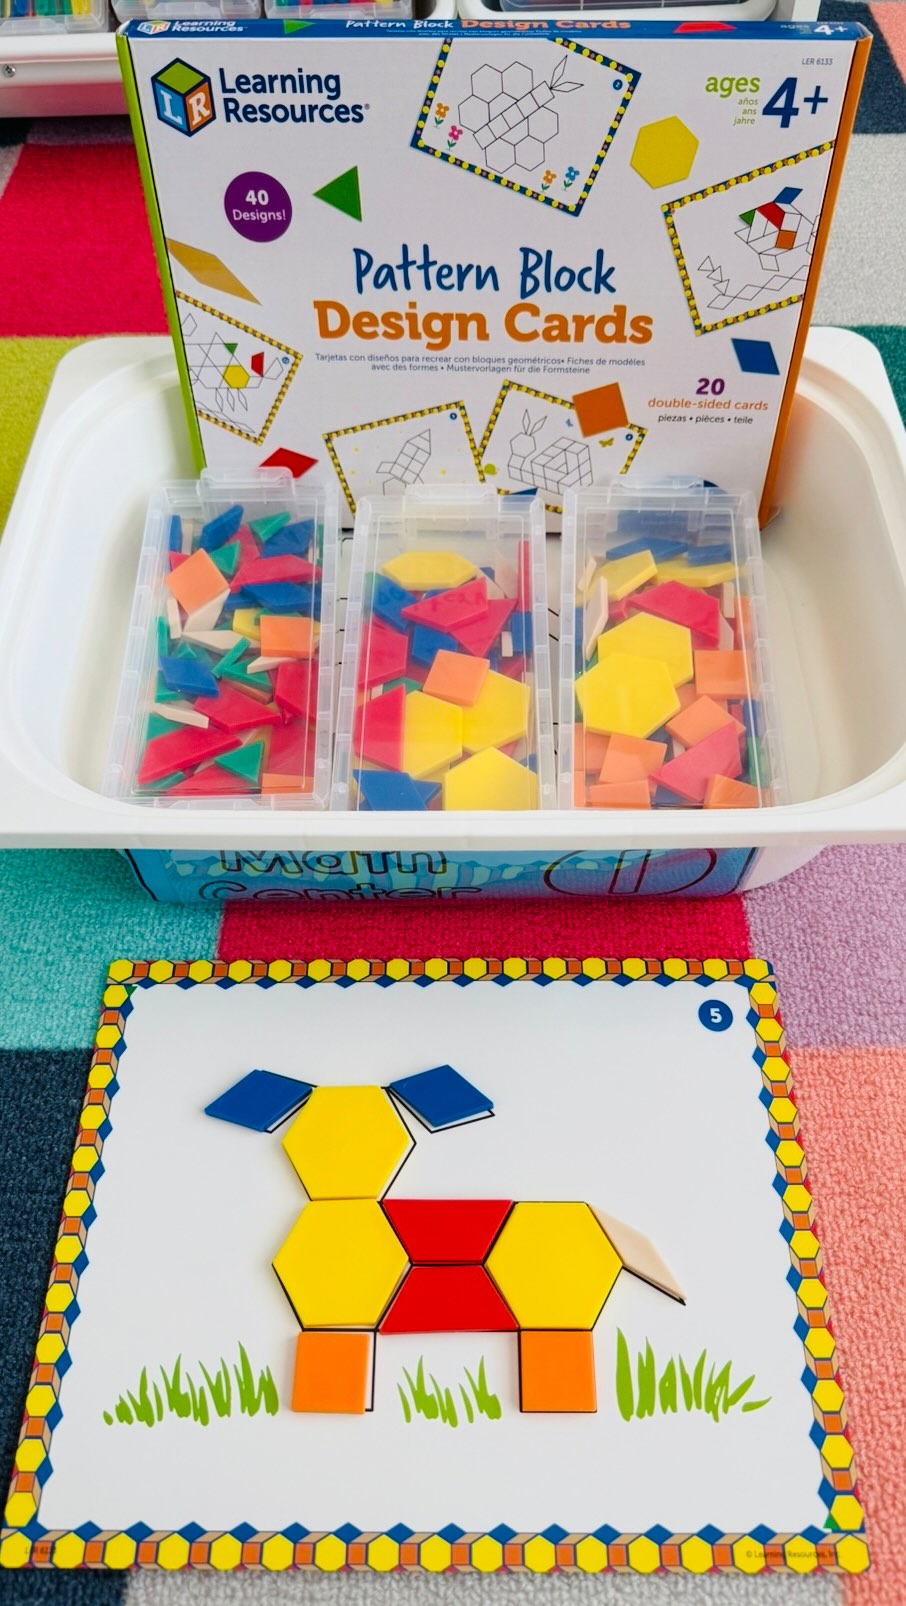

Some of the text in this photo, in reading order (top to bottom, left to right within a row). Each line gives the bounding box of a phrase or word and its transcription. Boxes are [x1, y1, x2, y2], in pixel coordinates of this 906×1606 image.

[346, 20, 632, 30] Pattern Block Design Cards
[802, 58, 834, 66] LER 6133
[218, 67, 342, 100] Learning
[705, 76, 761, 98] ages
[738, 98, 759, 106] años
[762, 76, 829, 128] 4+
[733, 116, 756, 126] jahre
[245, 189, 270, 206] 40
[232, 209, 286, 224] Designs!
[352, 243, 617, 300] Pattern Block
[312, 300, 654, 352] Design Cards
[315, 353, 348, 362] Tarjetas
[402, 356, 420, 364] para
[472, 356, 506, 367] bloques
[567, 357, 594, 365] Fiches
[596, 357, 607, 366] de
[609, 358, 646, 366] modèles
[392, 363, 407, 371] des
[409, 363, 439, 372] formes
[446, 364, 512, 374] Mustervorlagen
[514, 364, 525, 373] für
[528, 365, 541, 373] die
[542, 365, 590, 374] Formsteine
[696, 377, 726, 396] 20
[648, 397, 769, 411] double-sided cards
[658, 414, 687, 423] piezas
[734, 416, 753, 424] teile
[710, 1008, 722, 1024] 5
